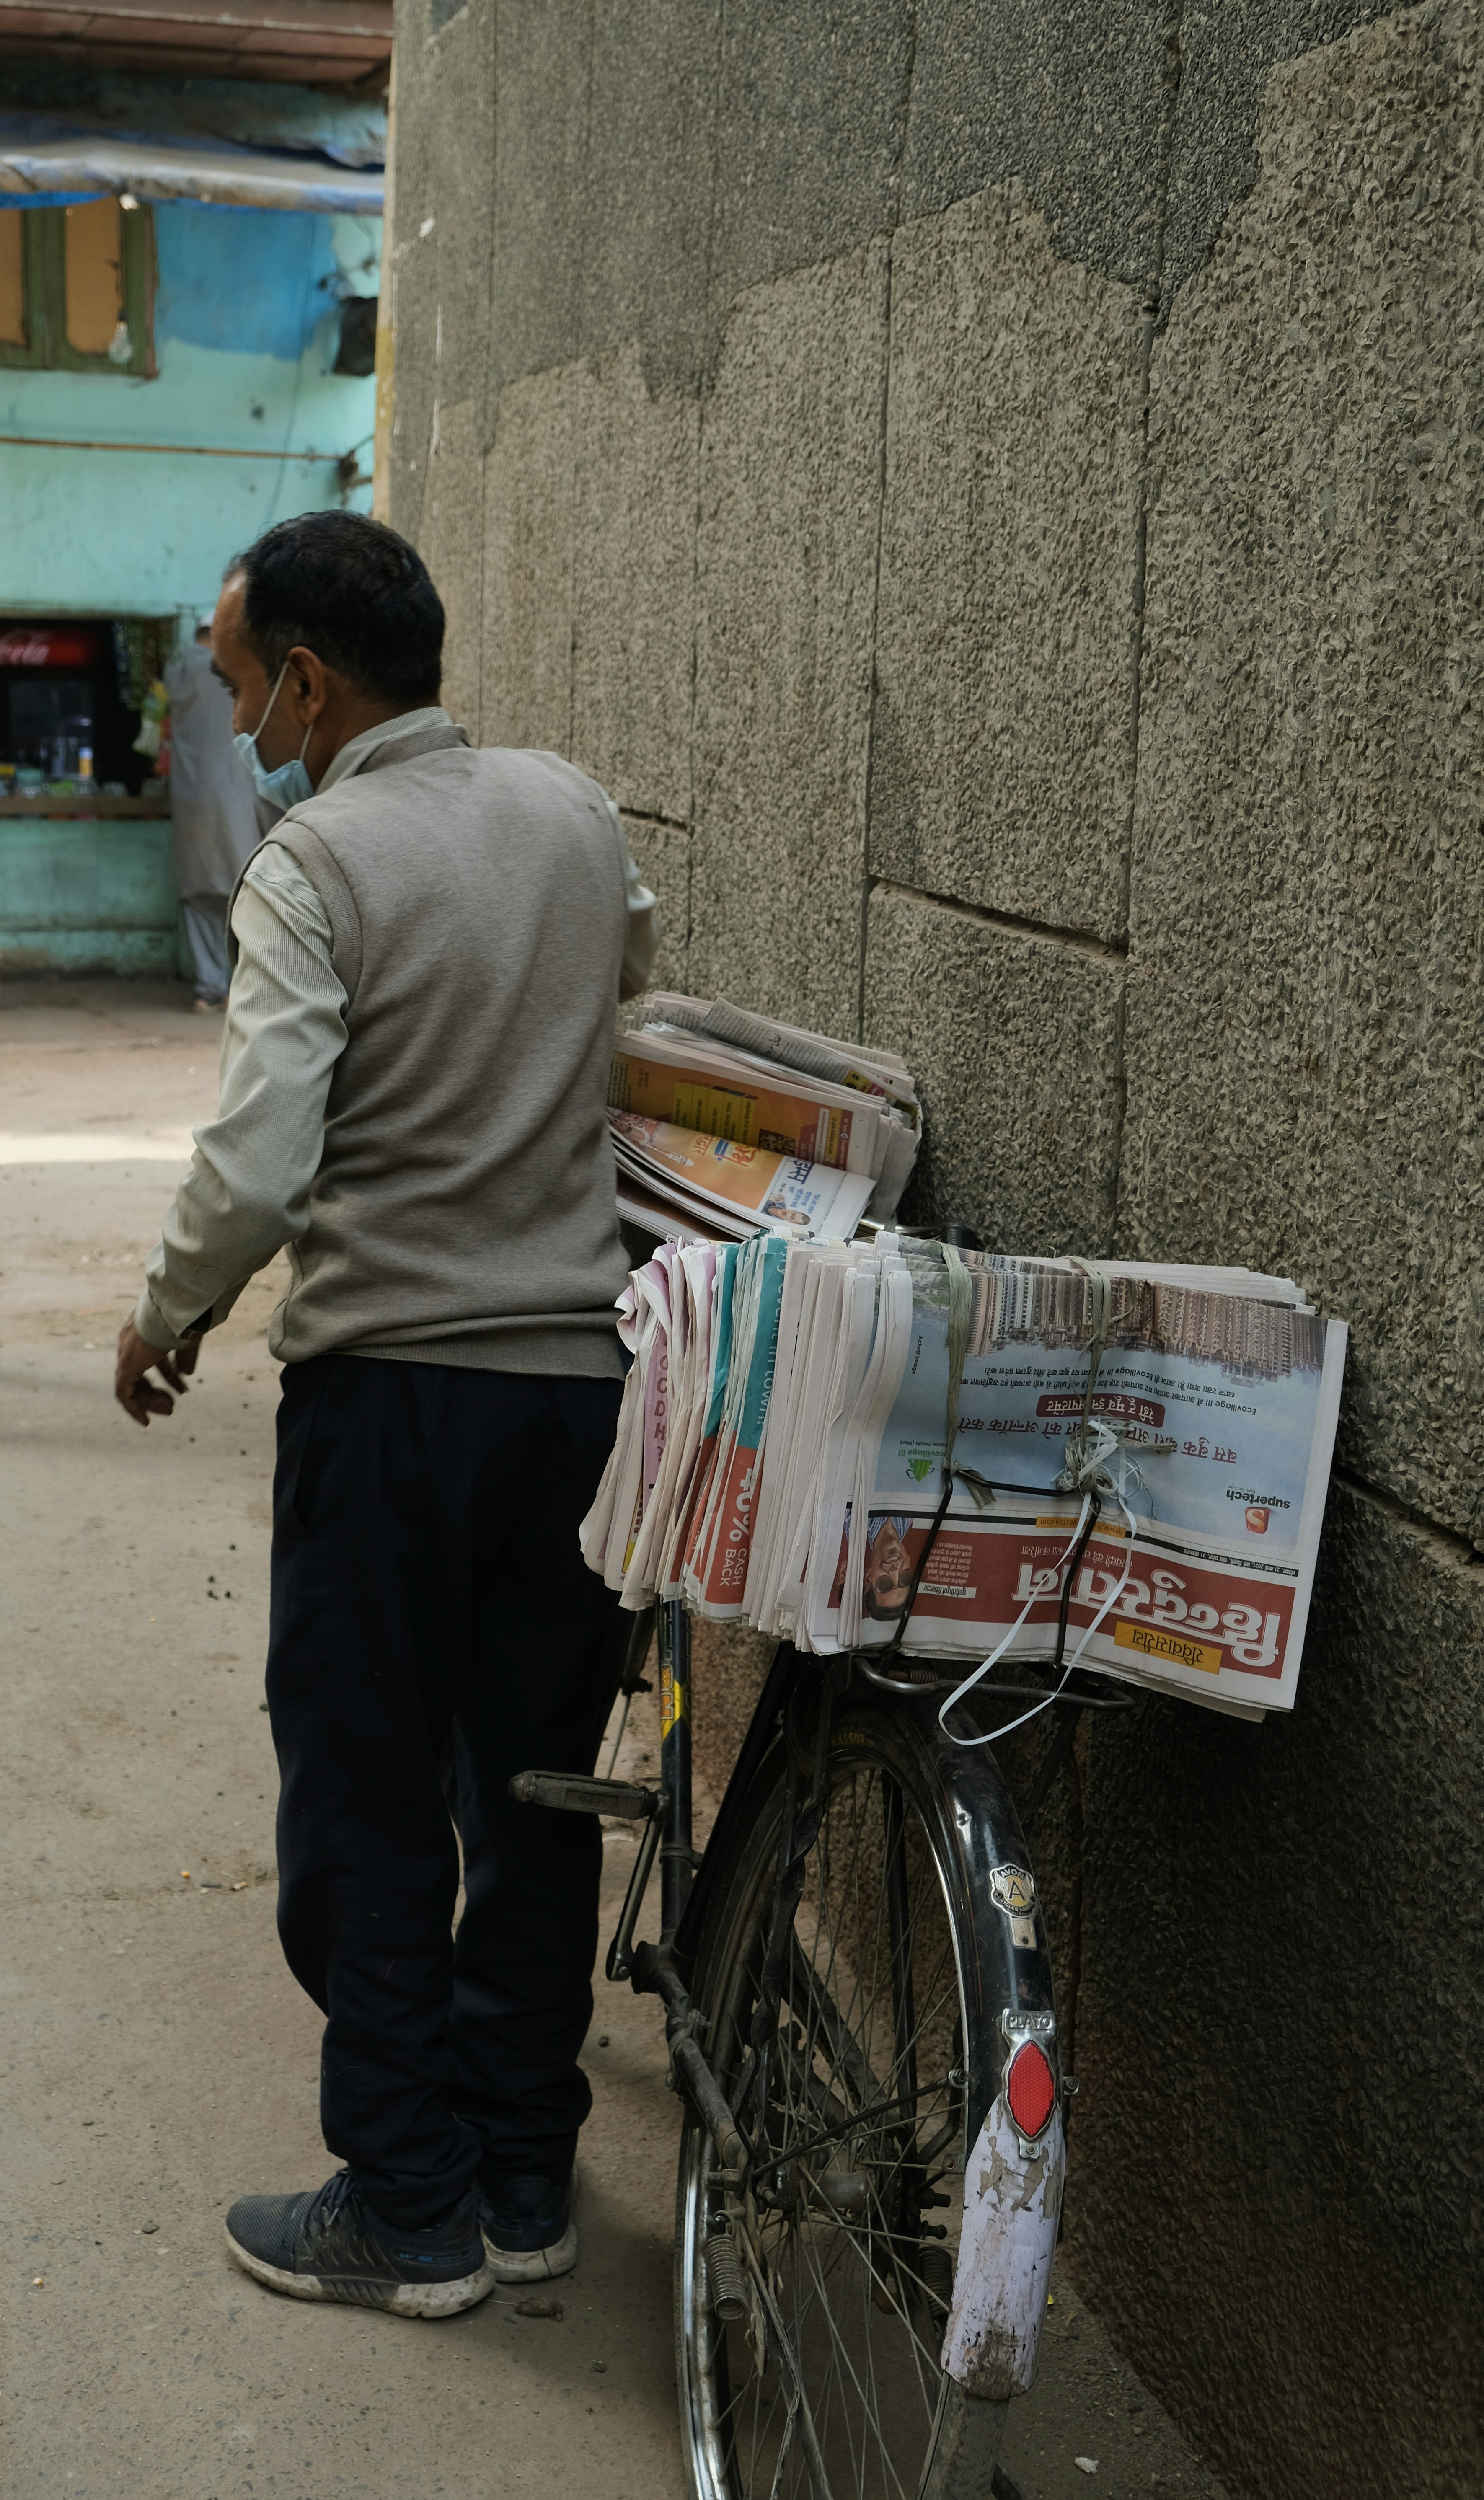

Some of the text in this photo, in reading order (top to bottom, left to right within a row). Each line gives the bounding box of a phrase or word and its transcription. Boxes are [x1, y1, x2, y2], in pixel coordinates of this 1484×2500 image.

[787, 1160, 814, 1184] इम्स
[912, 1355, 920, 1375] Image
[1015, 1366, 1032, 1375] तुरन्त
[1033, 1369, 1046, 1378] और
[1059, 1367, 1070, 1376] बुक
[1115, 1367, 1153, 1381] Ecovillage
[970, 1377, 999, 1387] सहूलियत
[1009, 1380, 1032, 1388] आपकी
[1033, 1380, 1044, 1388] बड़ी
[1045, 1381, 1052, 1389] से
[1052, 1381, 1067, 1389] छोटी
[1098, 1380, 1108, 1388] देख
[1109, 1379, 1119, 1388] राह
[1121, 1381, 1144, 1390] आपकी
[1154, 1375, 1160, 1384] ही
[1161, 1377, 1176, 1386] आज
[1145, 1385, 1153, 1393] घर
[1187, 1383, 1201, 1391] गया
[1202, 1386, 1217, 1394] रखा
[1218, 1388, 1235, 1398] ध्यान
[1153, 1388, 1170, 1399] अपना
[1171, 1393, 1195, 1403] आपका
[1106, 1395, 1125, 1412] मूव
[1127, 1397, 1136, 1414] टू
[1215, 1401, 1256, 1415] Ecovillage
[1138, 1405, 1154, 1425] रेडी
[957, 1418, 985, 1433] करो
[987, 1420, 1038, 1435] अन्लॉक
[1041, 1422, 1062, 1440] को
[1181, 1437, 1210, 1459] बुक
[1212, 1447, 1237, 1464] बस
[729, 1468, 752, 1541] 40%
[1226, 1489, 1290, 1509] supertech
[1021, 1546, 1050, 1558] नजरिया
[1052, 1546, 1066, 1556] नया
[1092, 1551, 1104, 1563] को
[719, 1549, 736, 1586] BACK
[732, 1548, 747, 1585] CASH
[1229, 1557, 1242, 1567] दिल्ली,
[923, 1585, 966, 1597] चुनौतीपूर्ण किरदार
[1011, 1563, 1280, 1667] हिन्दुस्तान
[1130, 1629, 1204, 1666] रविवासरीय
[1001, 1868, 1025, 1879] AVON
[1009, 1880, 1025, 1900] A
[1008, 2016, 1052, 2029] PLATO
